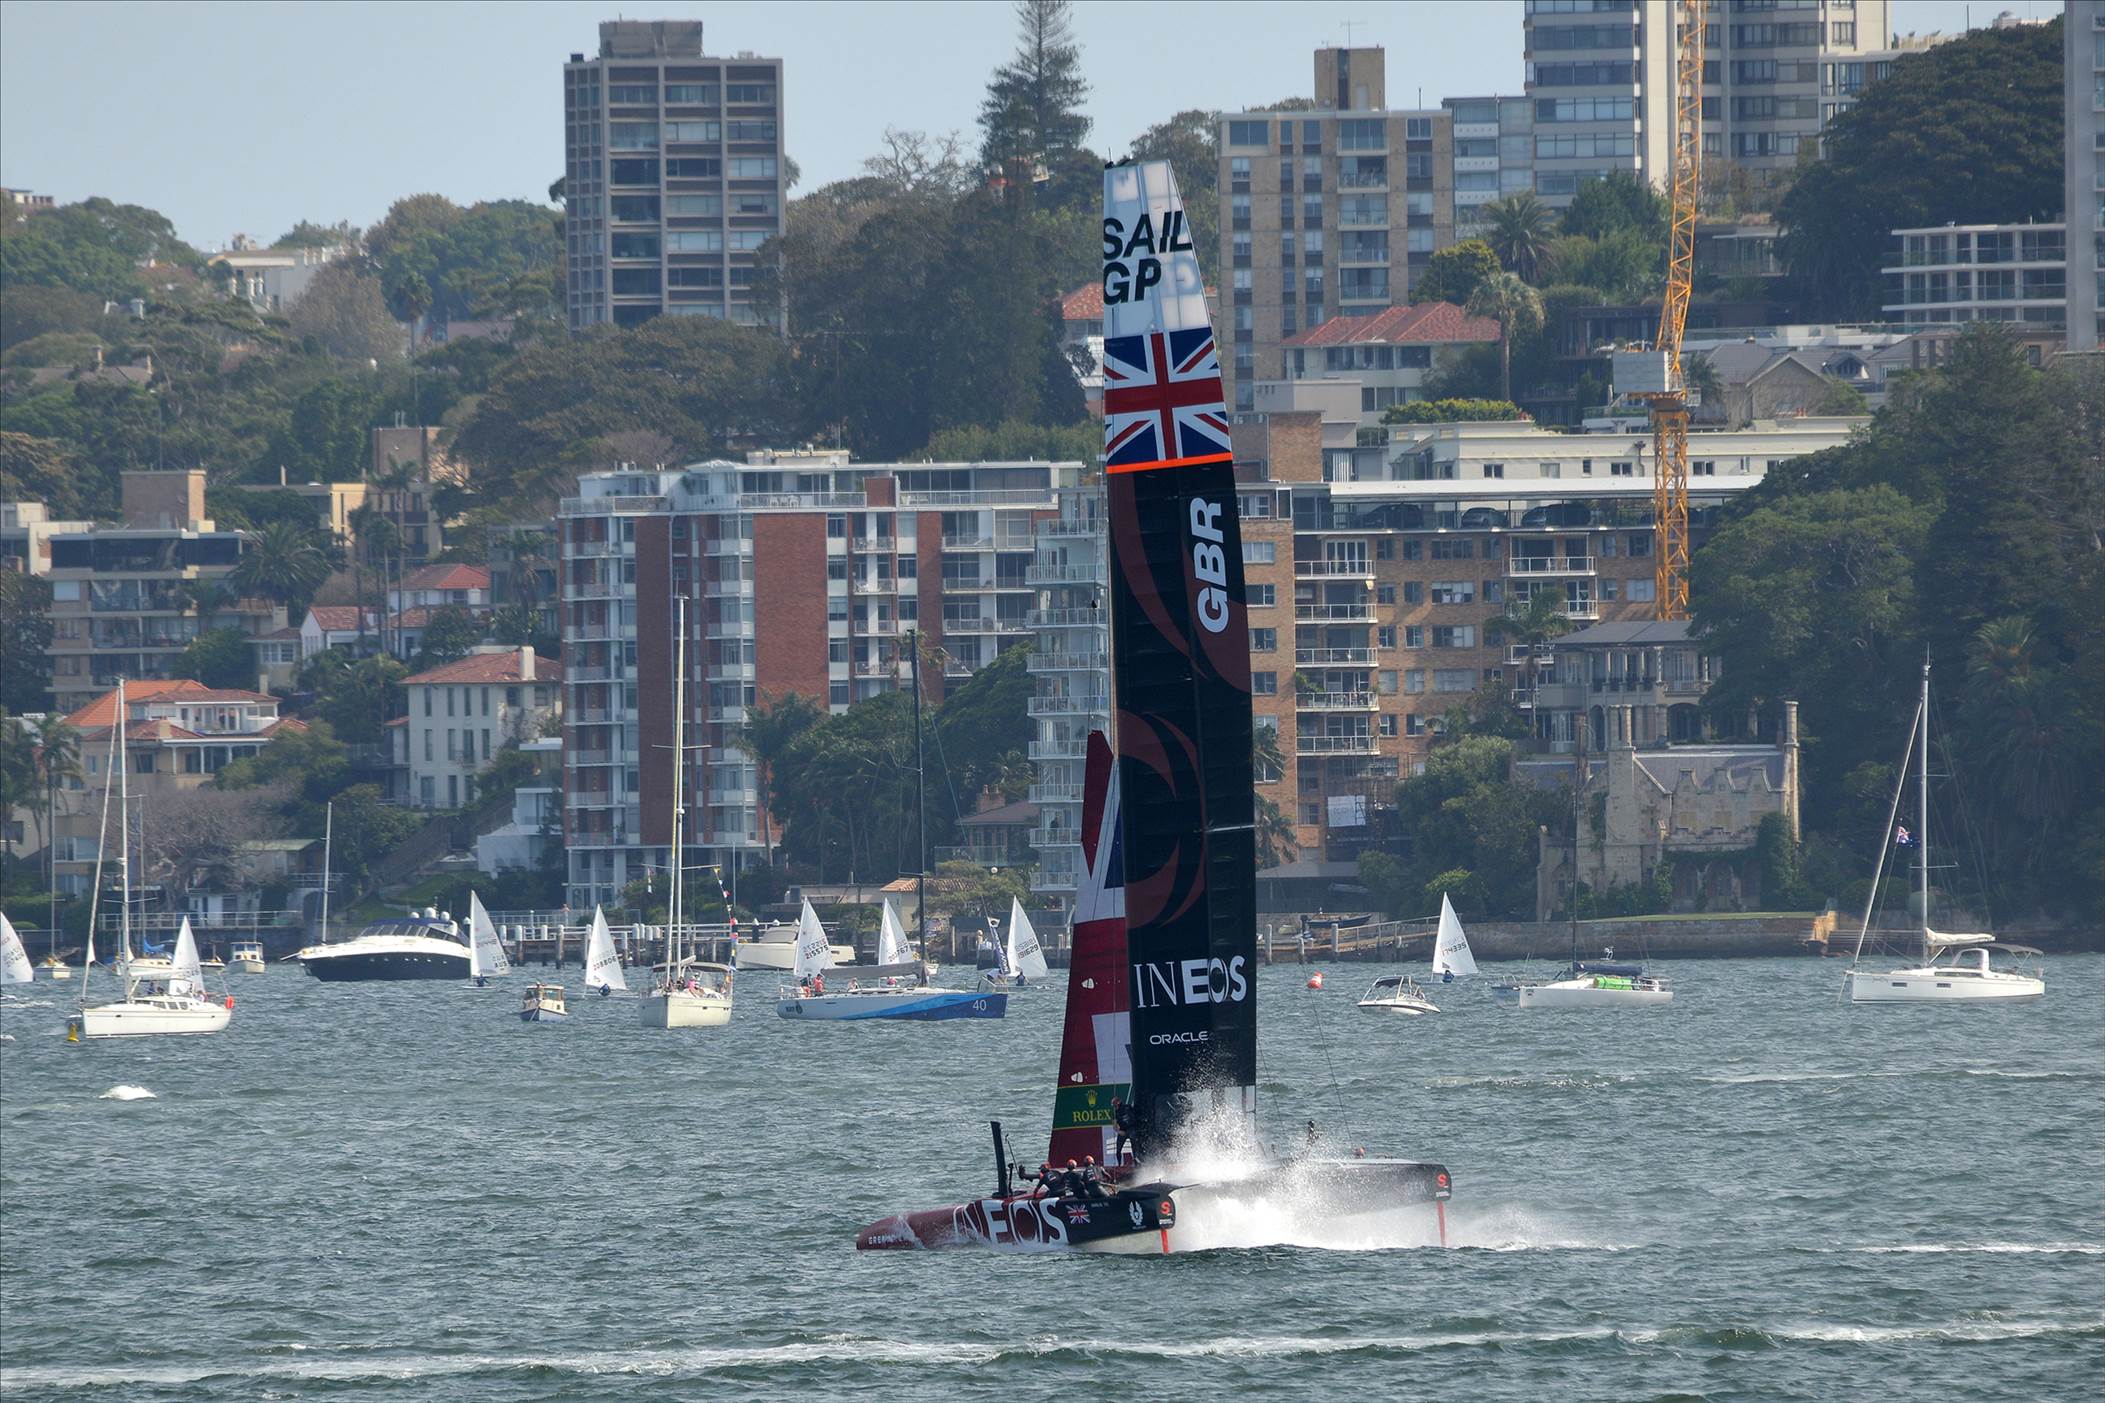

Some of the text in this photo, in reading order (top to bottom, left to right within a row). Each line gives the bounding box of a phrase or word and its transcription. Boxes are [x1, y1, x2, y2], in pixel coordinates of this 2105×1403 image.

[1103, 210, 1193, 262] SAIL
[1103, 258, 1162, 305] GP
[1189, 497, 1230, 634] GBR
[805, 945, 830, 960] 215575
[1133, 955, 1248, 1009] INEOS
[972, 999, 987, 1012] 40
[1149, 1030, 1209, 1046] ORACLE
[1072, 1109, 1113, 1123] ROLEX
